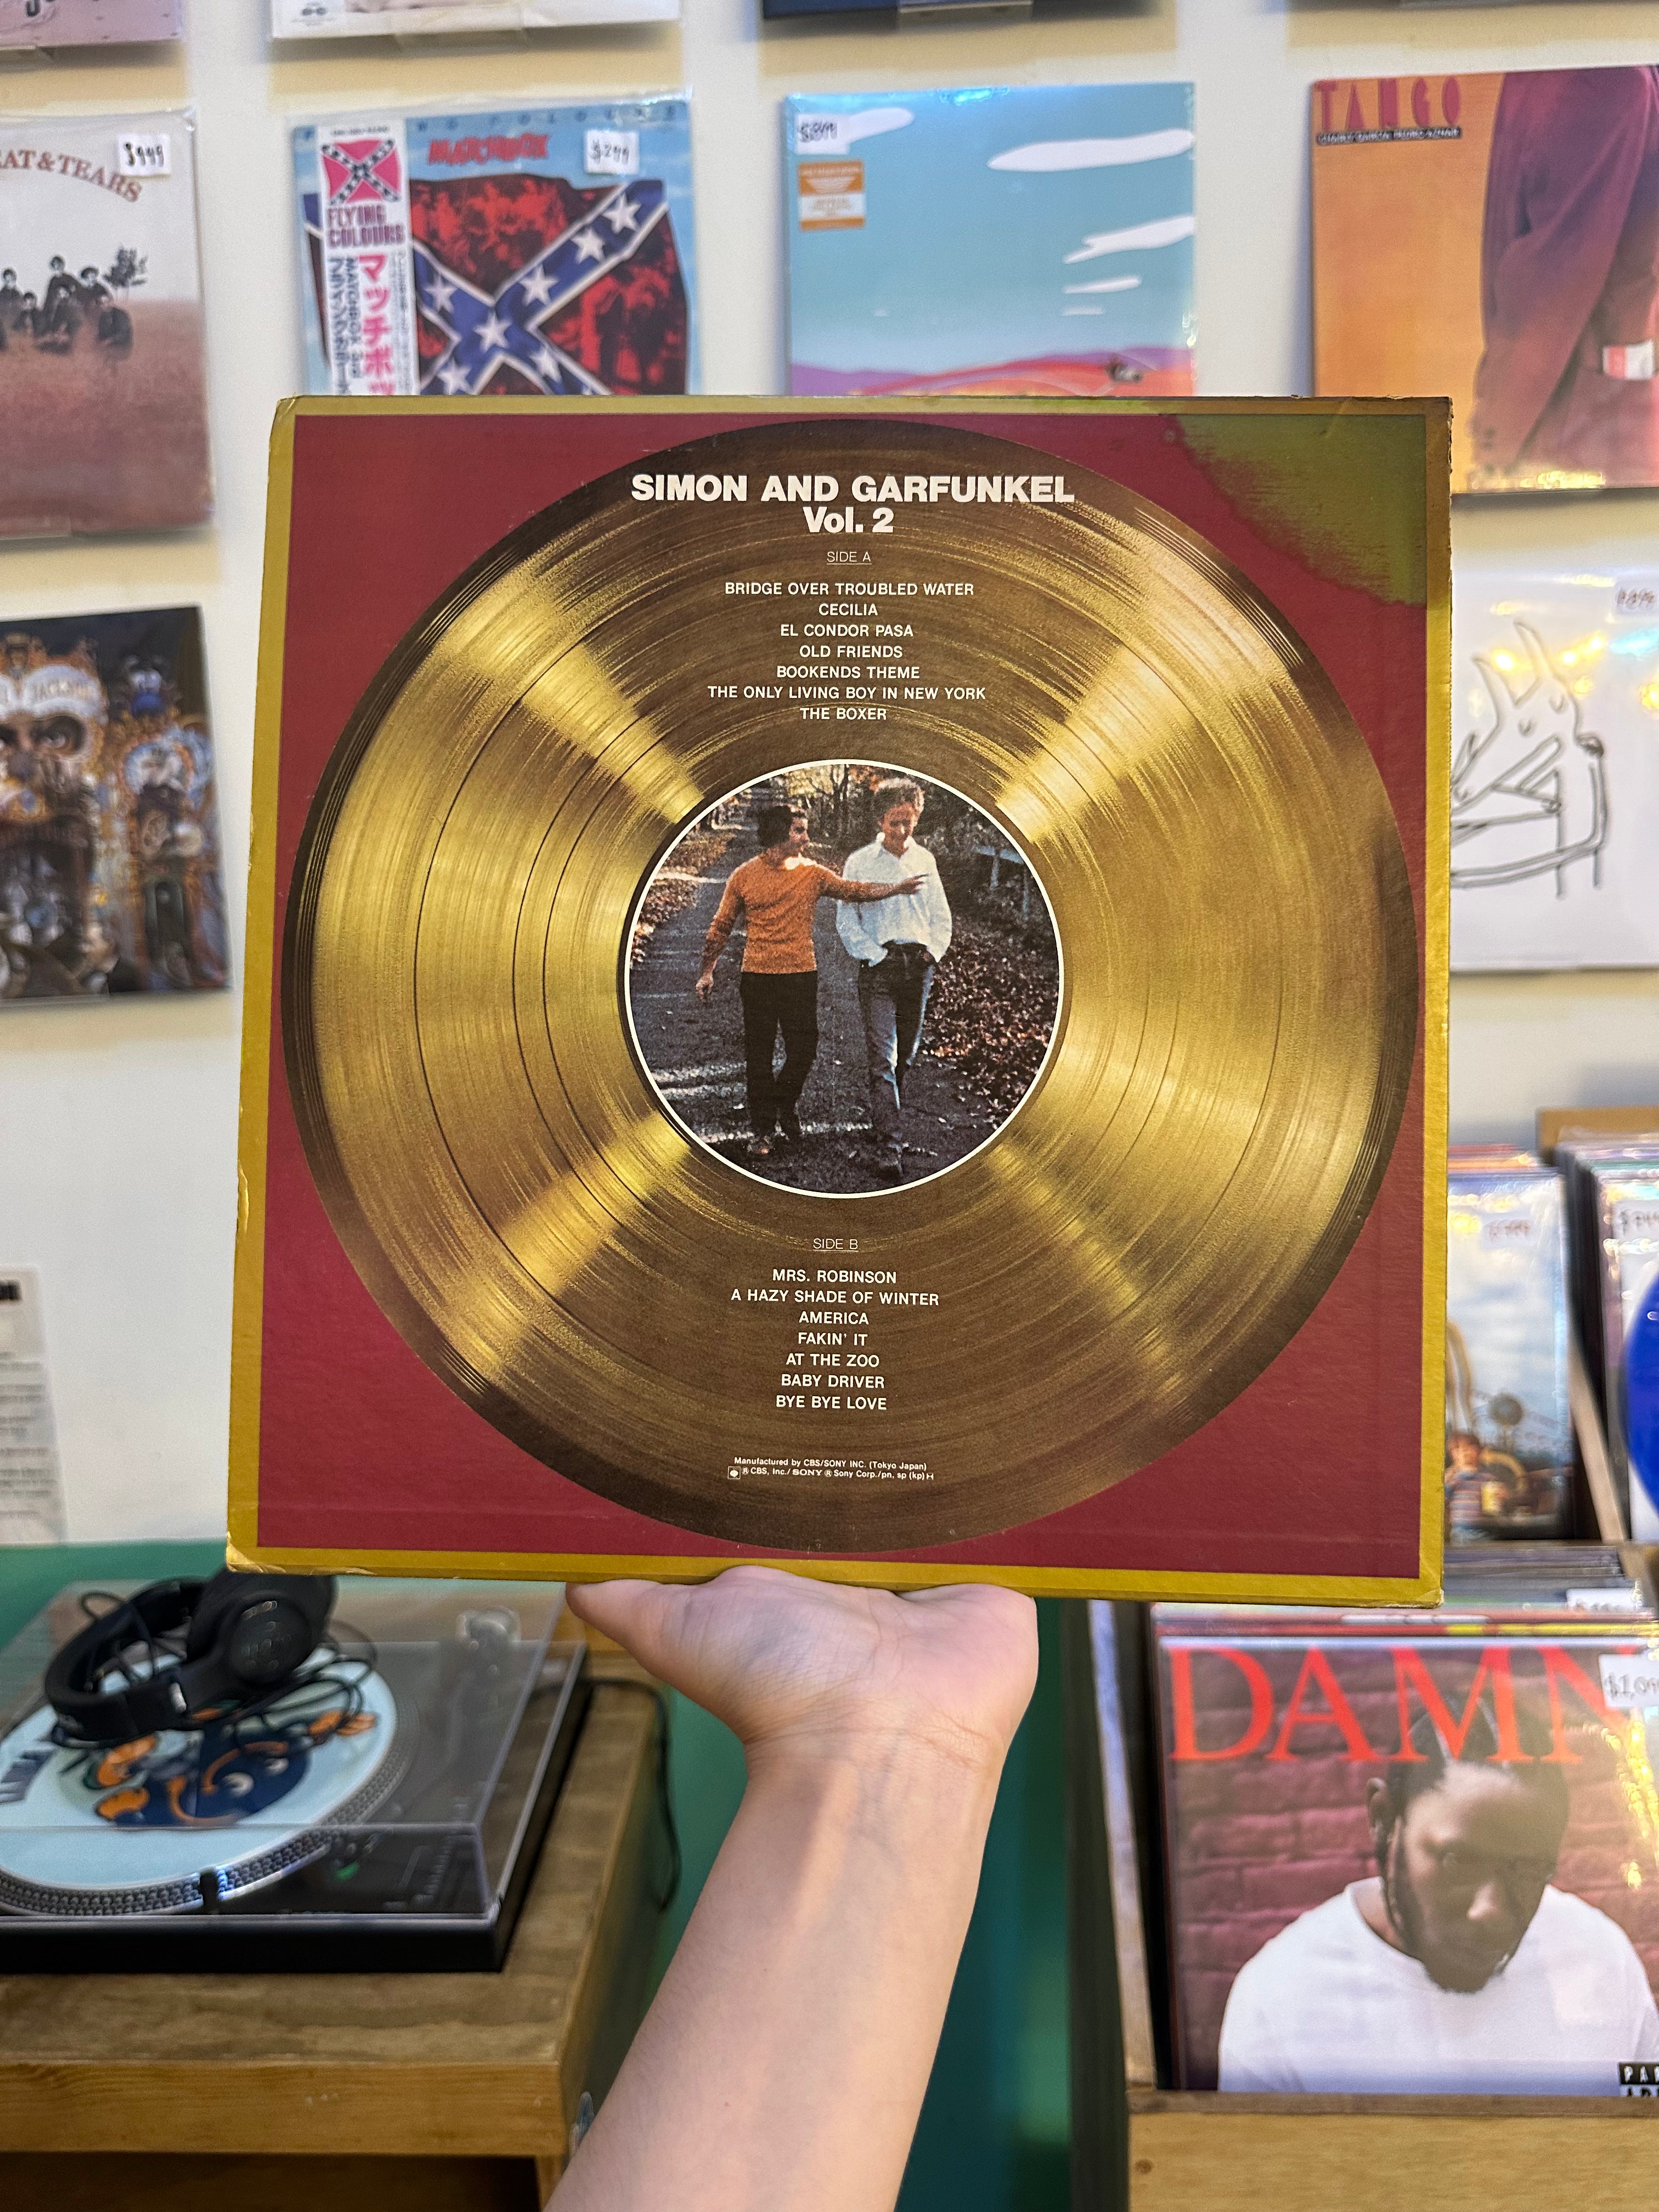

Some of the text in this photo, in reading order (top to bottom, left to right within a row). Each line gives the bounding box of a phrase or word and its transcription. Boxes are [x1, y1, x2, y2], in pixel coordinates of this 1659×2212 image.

[1317, 77, 1462, 133] TANGO
[631, 474, 1075, 503] SIMON AND GARFUNKEL
[803, 506, 894, 533] Vol. 2
[826, 551, 872, 563] SIDE A
[725, 582, 974, 596] BRIDGE OVER TROUBLED WATER
[819, 603, 878, 616] CECILIA
[780, 624, 914, 637] EL CONDOR PASA
[799, 645, 903, 658] OLD FRIENDS
[777, 665, 920, 679] BOOKENDS THEME
[707, 685, 986, 700] THE ONLY LIVING BOY IN NEW YORK
[799, 707, 888, 720] THE BOXER
[812, 1237, 859, 1250] SIDE B
[772, 1268, 896, 1284] MRS. ROBINSON
[731, 1288, 939, 1306] A HAZY SHADE OF WINTER
[799, 1311, 869, 1325] AMERICA
[854, 1333, 868, 1346] IT
[786, 1353, 879, 1368] AT THE ZOO
[781, 1374, 884, 1389] BABY DRIVER
[776, 1395, 887, 1410] BYE BYE LOVE
[733, 1457, 927, 1471] Manufactured by CBS/SONY INC. (Tokyo Japan)
[833, 1469, 854, 1479] Sony
[1170, 1646, 1641, 1763] DAMN
